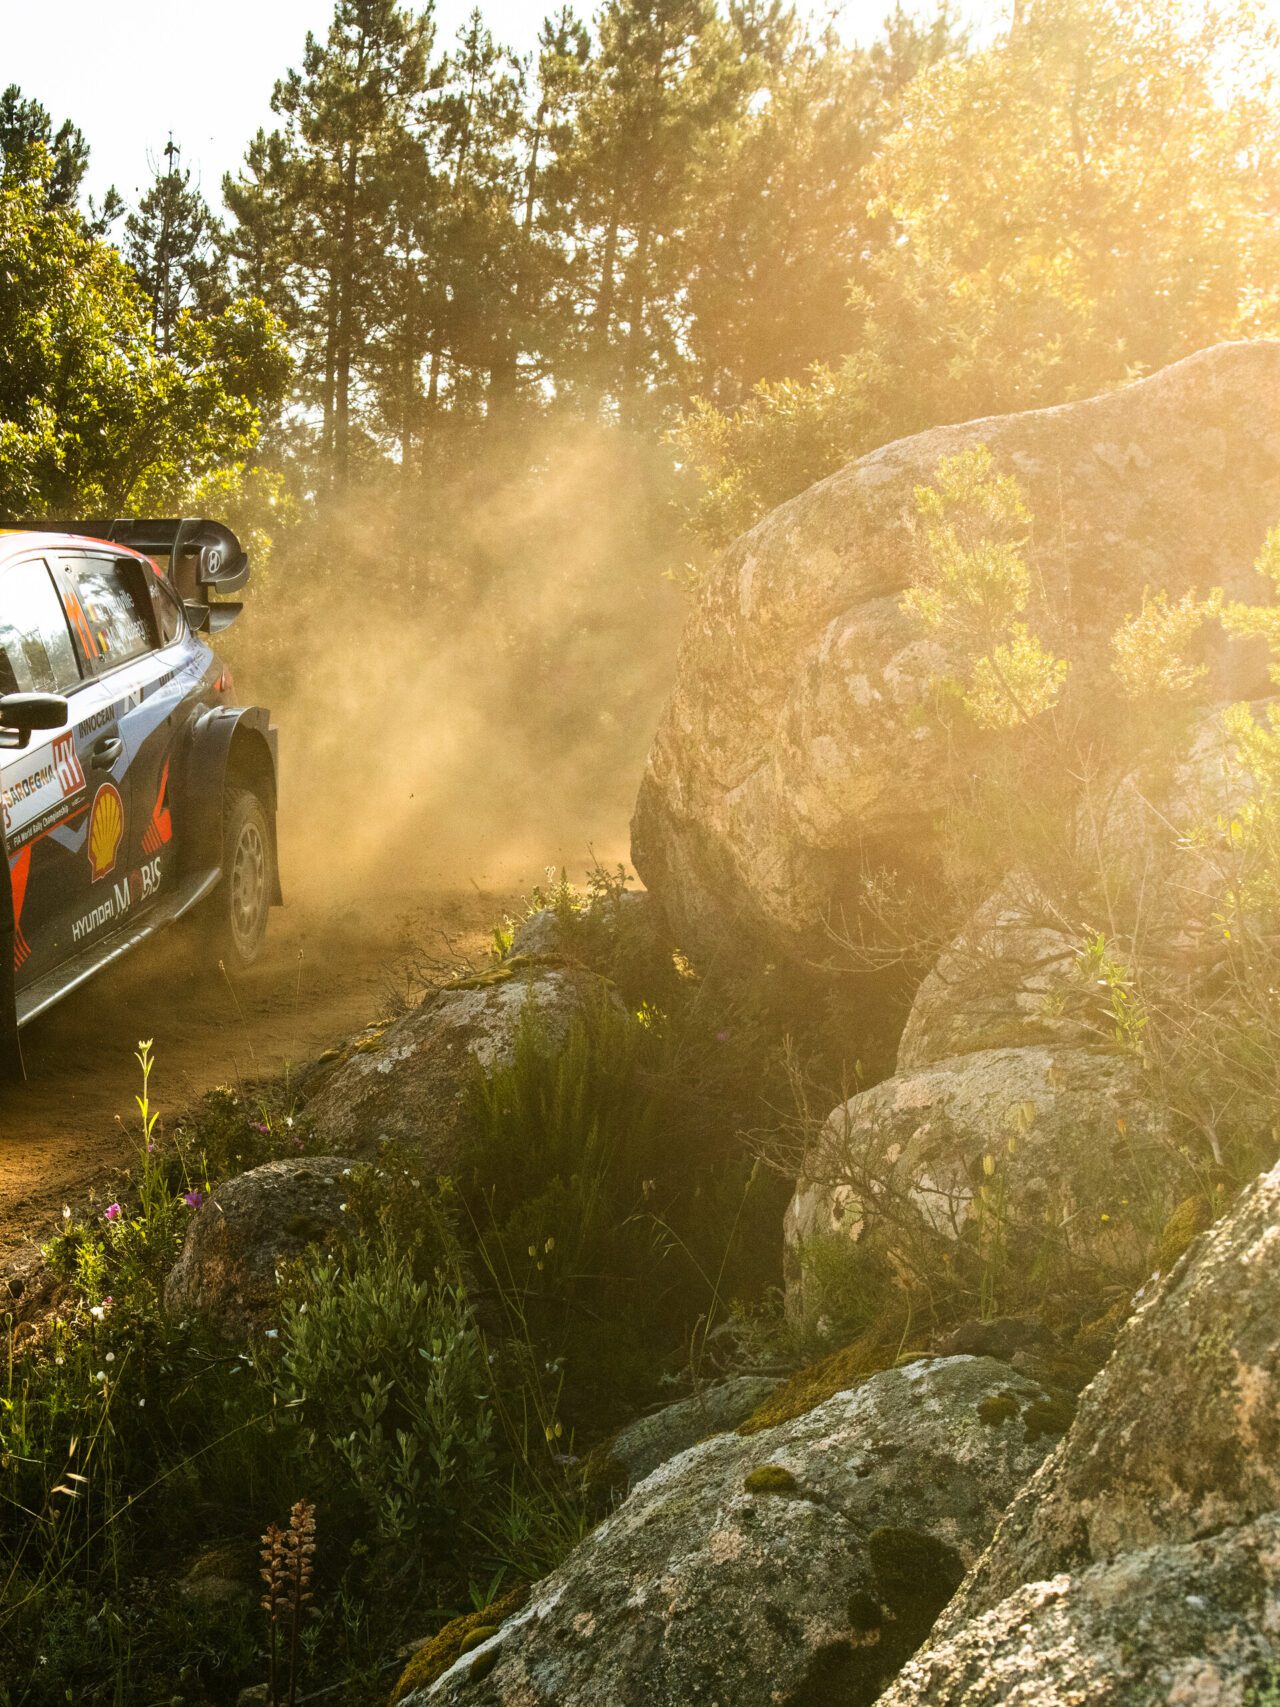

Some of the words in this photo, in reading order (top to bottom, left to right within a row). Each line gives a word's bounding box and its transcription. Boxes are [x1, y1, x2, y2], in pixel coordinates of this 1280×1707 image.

[78, 704, 115, 738] INNOCEAN
[2, 764, 56, 809] SARDEGNA
[72, 899, 114, 942] HYUNDAI
[114, 856, 162, 920] MOBIS
